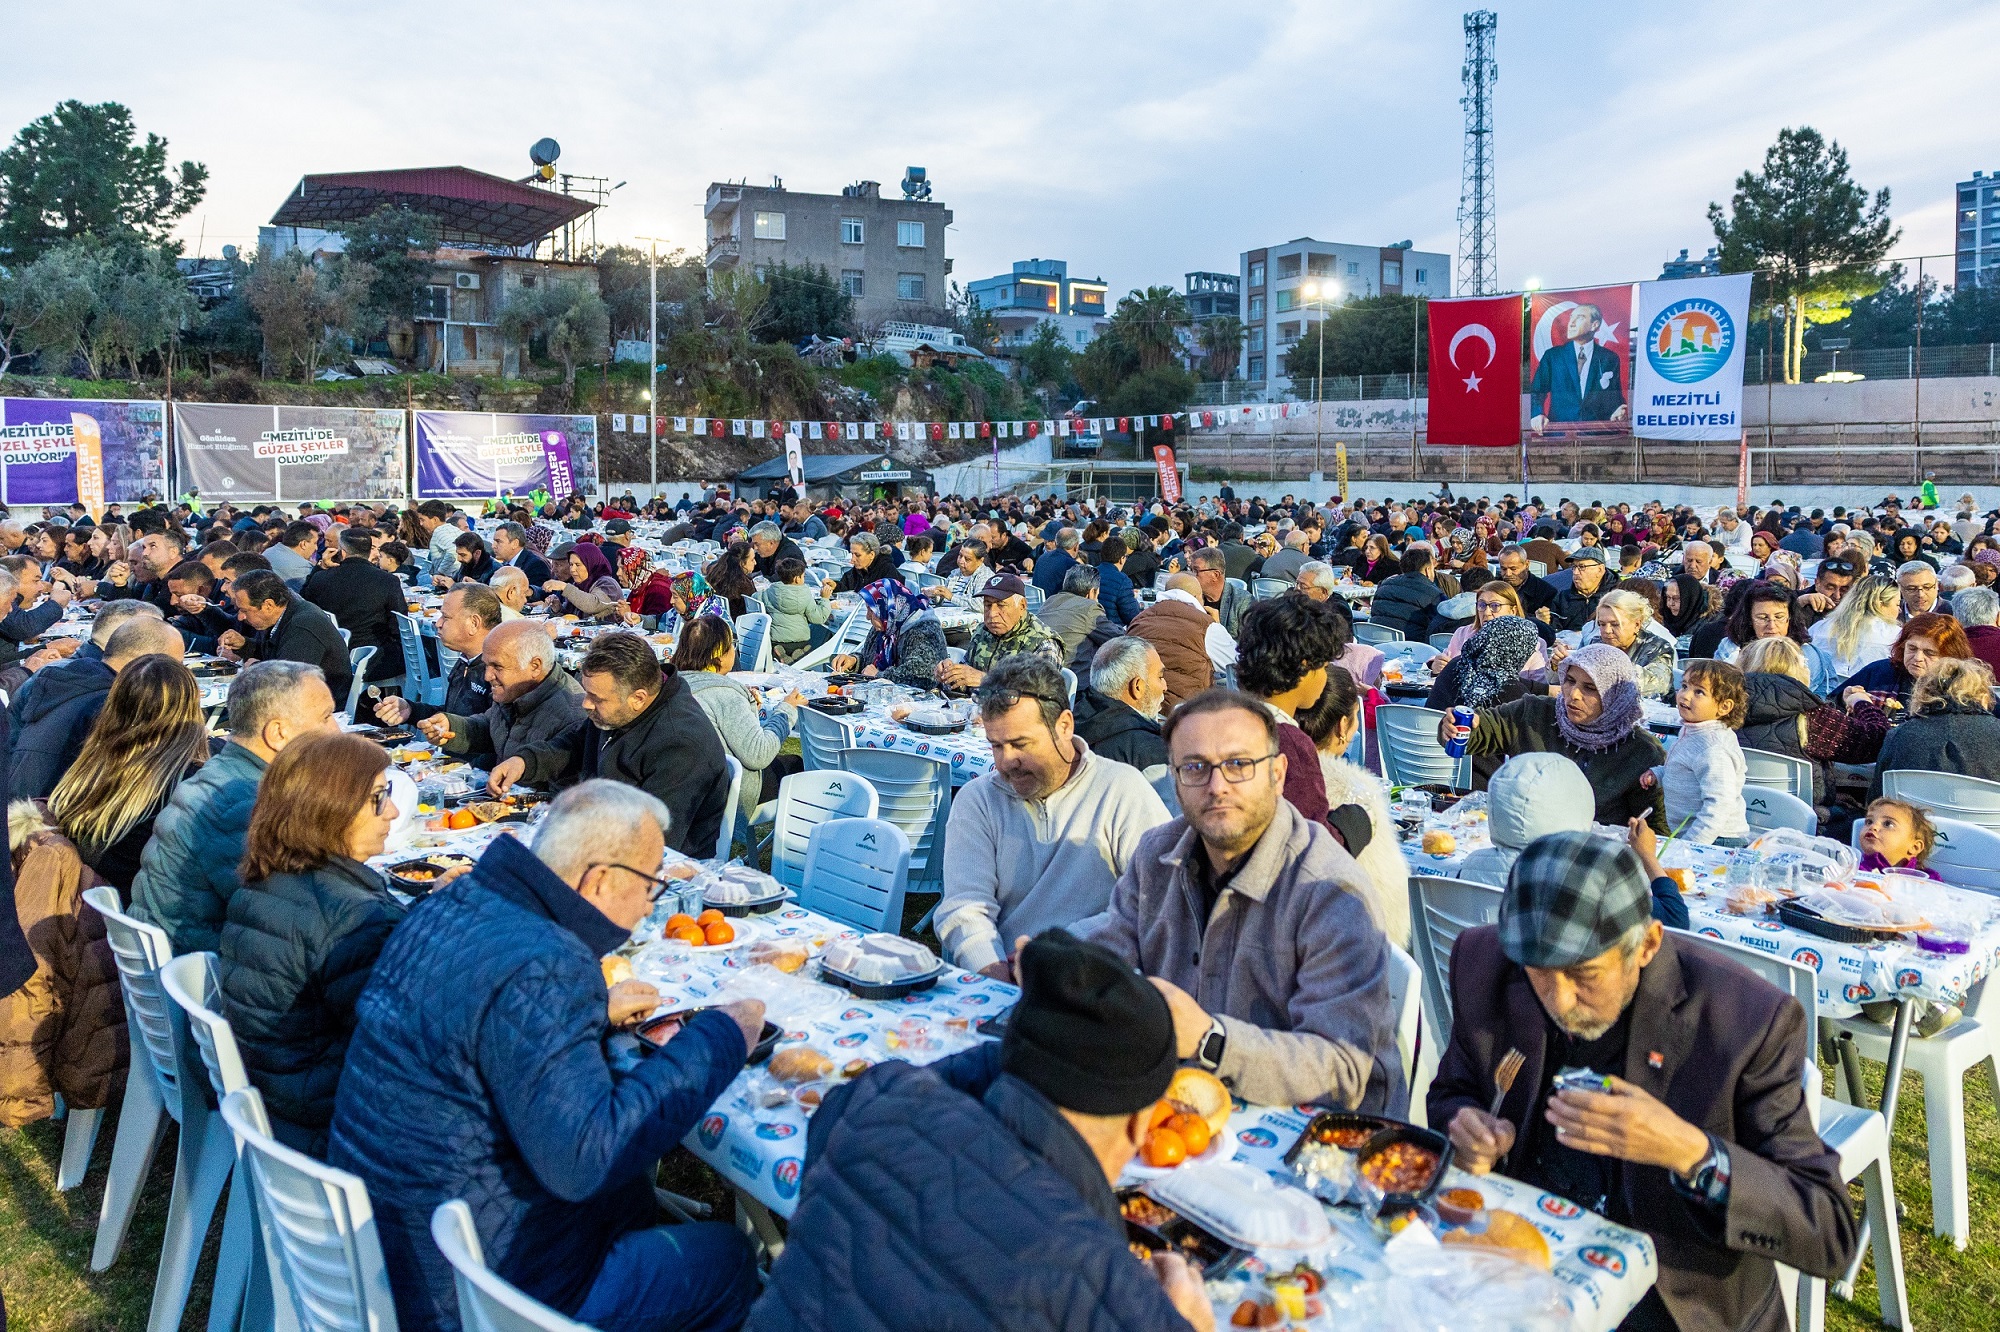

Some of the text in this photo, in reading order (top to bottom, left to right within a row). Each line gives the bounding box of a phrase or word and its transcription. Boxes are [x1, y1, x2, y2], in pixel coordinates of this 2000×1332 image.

[1649, 302, 1731, 353] MEZİTLİ BELEDİYESİ
[1652, 391, 1720, 407] MEZİTLİ
[1637, 411, 1735, 426] BELEDİYESİ
[0, 436, 76, 452] ZEL ŞEYLE
[258, 440, 344, 455] GÜZEL ŞEYLER
[481, 445, 514, 457] GÜZEL
[515, 443, 543, 456] ŞEYLE
[1739, 934, 1779, 950] MEZİTLİ
